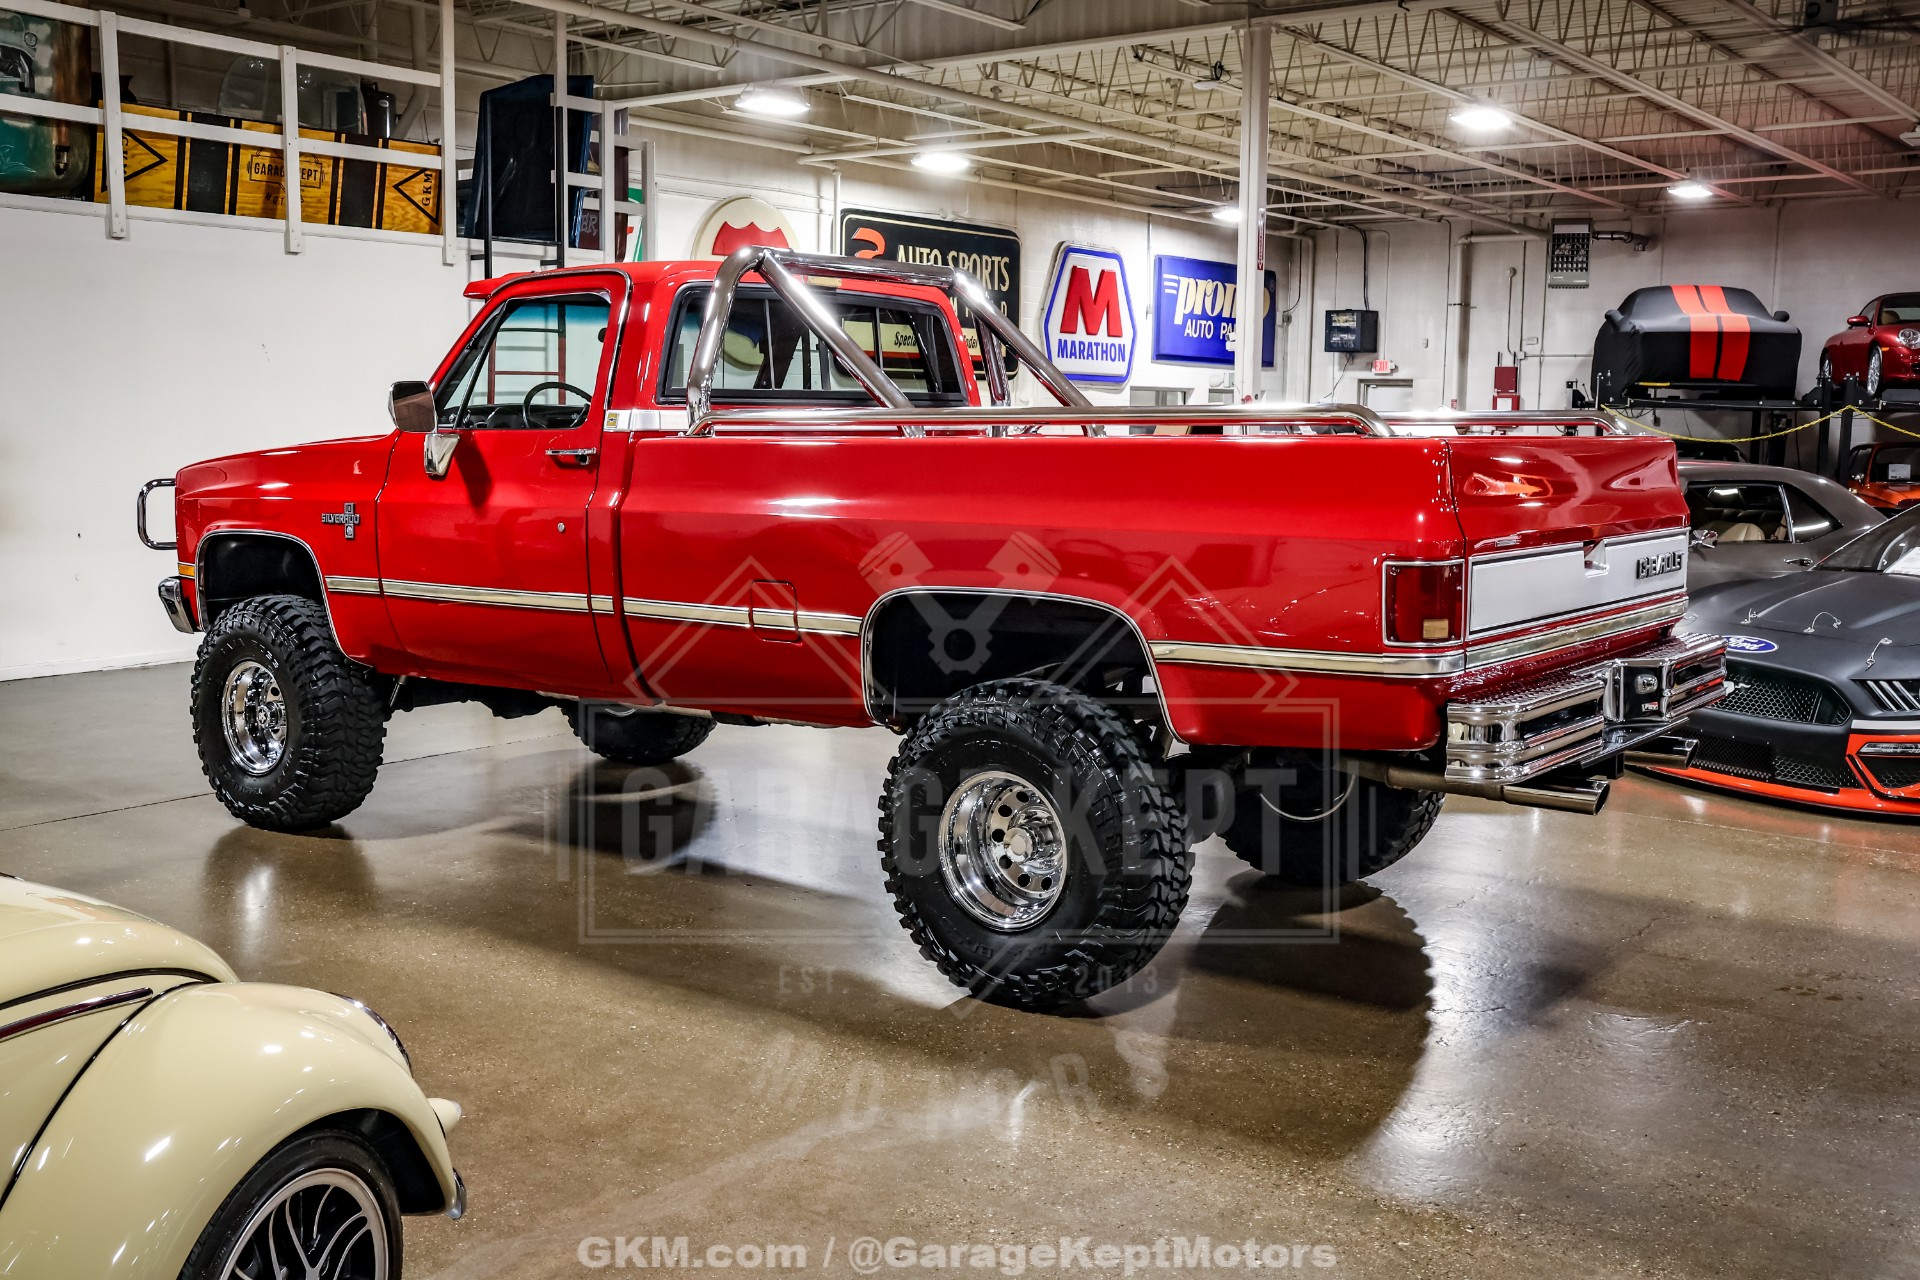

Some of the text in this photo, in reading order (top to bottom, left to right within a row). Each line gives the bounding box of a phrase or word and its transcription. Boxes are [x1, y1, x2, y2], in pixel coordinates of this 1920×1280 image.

[254, 162, 285, 178] GARAG
[421, 172, 433, 206] GKM
[1060, 265, 1123, 338] M
[1184, 318, 1214, 340] AUTO
[1057, 338, 1126, 363] MARATHON
[1375, 360, 1389, 372] EXIT
[321, 512, 360, 525] SILVERADO
[1635, 550, 1685, 580] CHEVROLET
